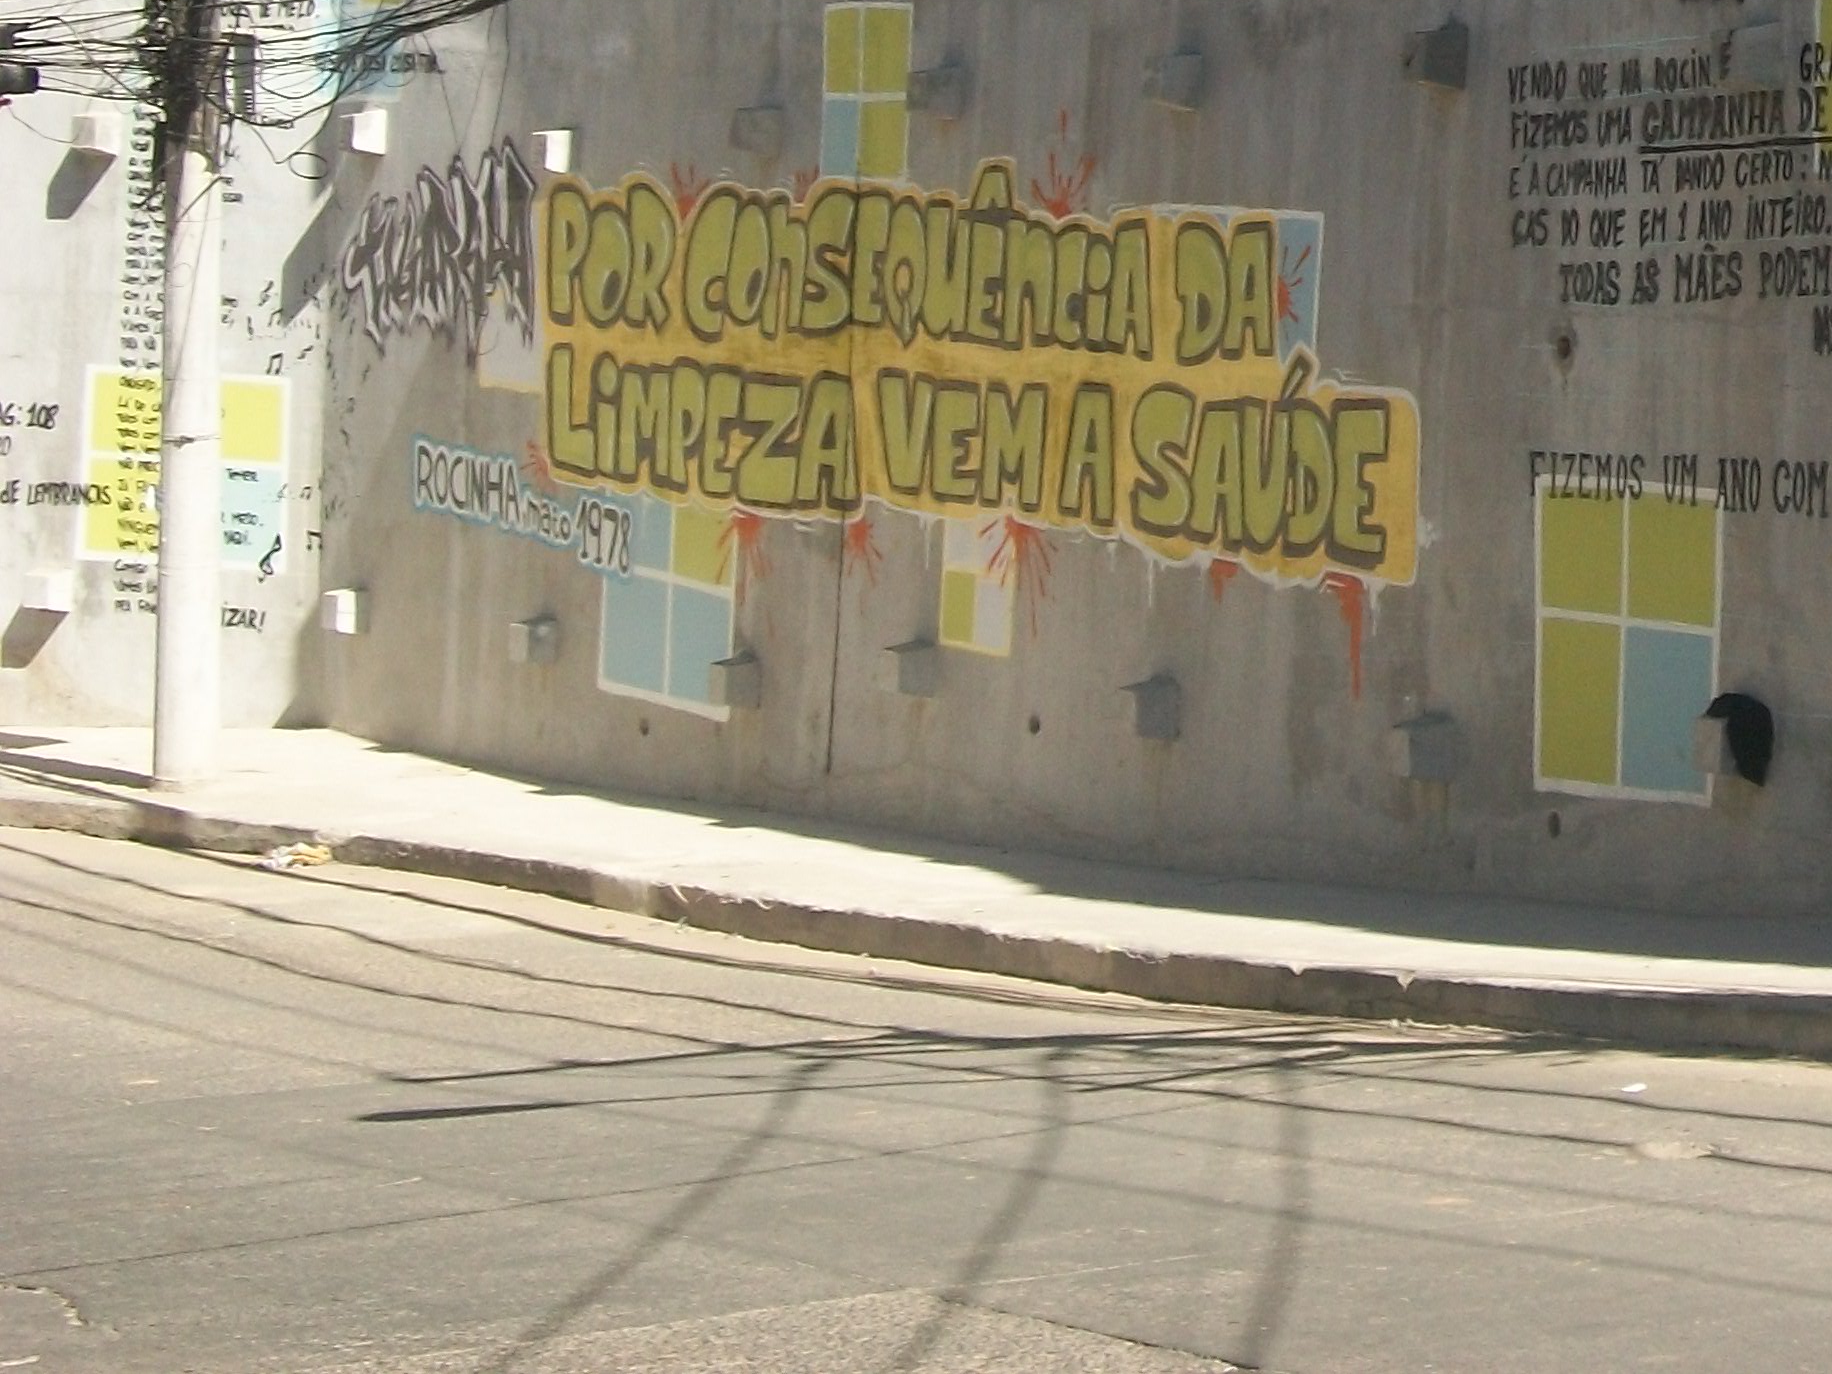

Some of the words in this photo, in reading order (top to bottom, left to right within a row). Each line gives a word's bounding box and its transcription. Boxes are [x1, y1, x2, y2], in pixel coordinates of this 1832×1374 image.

[1508, 61, 1568, 106] VENDO
[1578, 60, 1609, 101] QUE
[1597, 106, 1633, 148] UMA
[1797, 86, 1829, 133] DE
[1560, 207, 1580, 247] DO
[1589, 206, 1627, 247] QUE
[1639, 206, 1668, 248] EM
[1678, 199, 1689, 242] 1
[1697, 199, 1733, 241] ANO
[546, 182, 677, 335] POR
[1175, 219, 1276, 366] DA
[1559, 259, 1621, 306] TODAS
[1631, 257, 1661, 305] AS
[1758, 245, 1832, 299] PODEM
[24, 403, 60, 429] 108
[875, 367, 1049, 513] VEM
[1058, 382, 1116, 526] A
[1128, 356, 1391, 568] SAÚDE
[1528, 450, 1647, 502] FIZEMOS
[1662, 452, 1699, 508] UM
[1714, 456, 1761, 513] ANO
[1772, 458, 1830, 519] COM
[417, 444, 520, 527] ROCINHA
[575, 498, 631, 574] 1978
